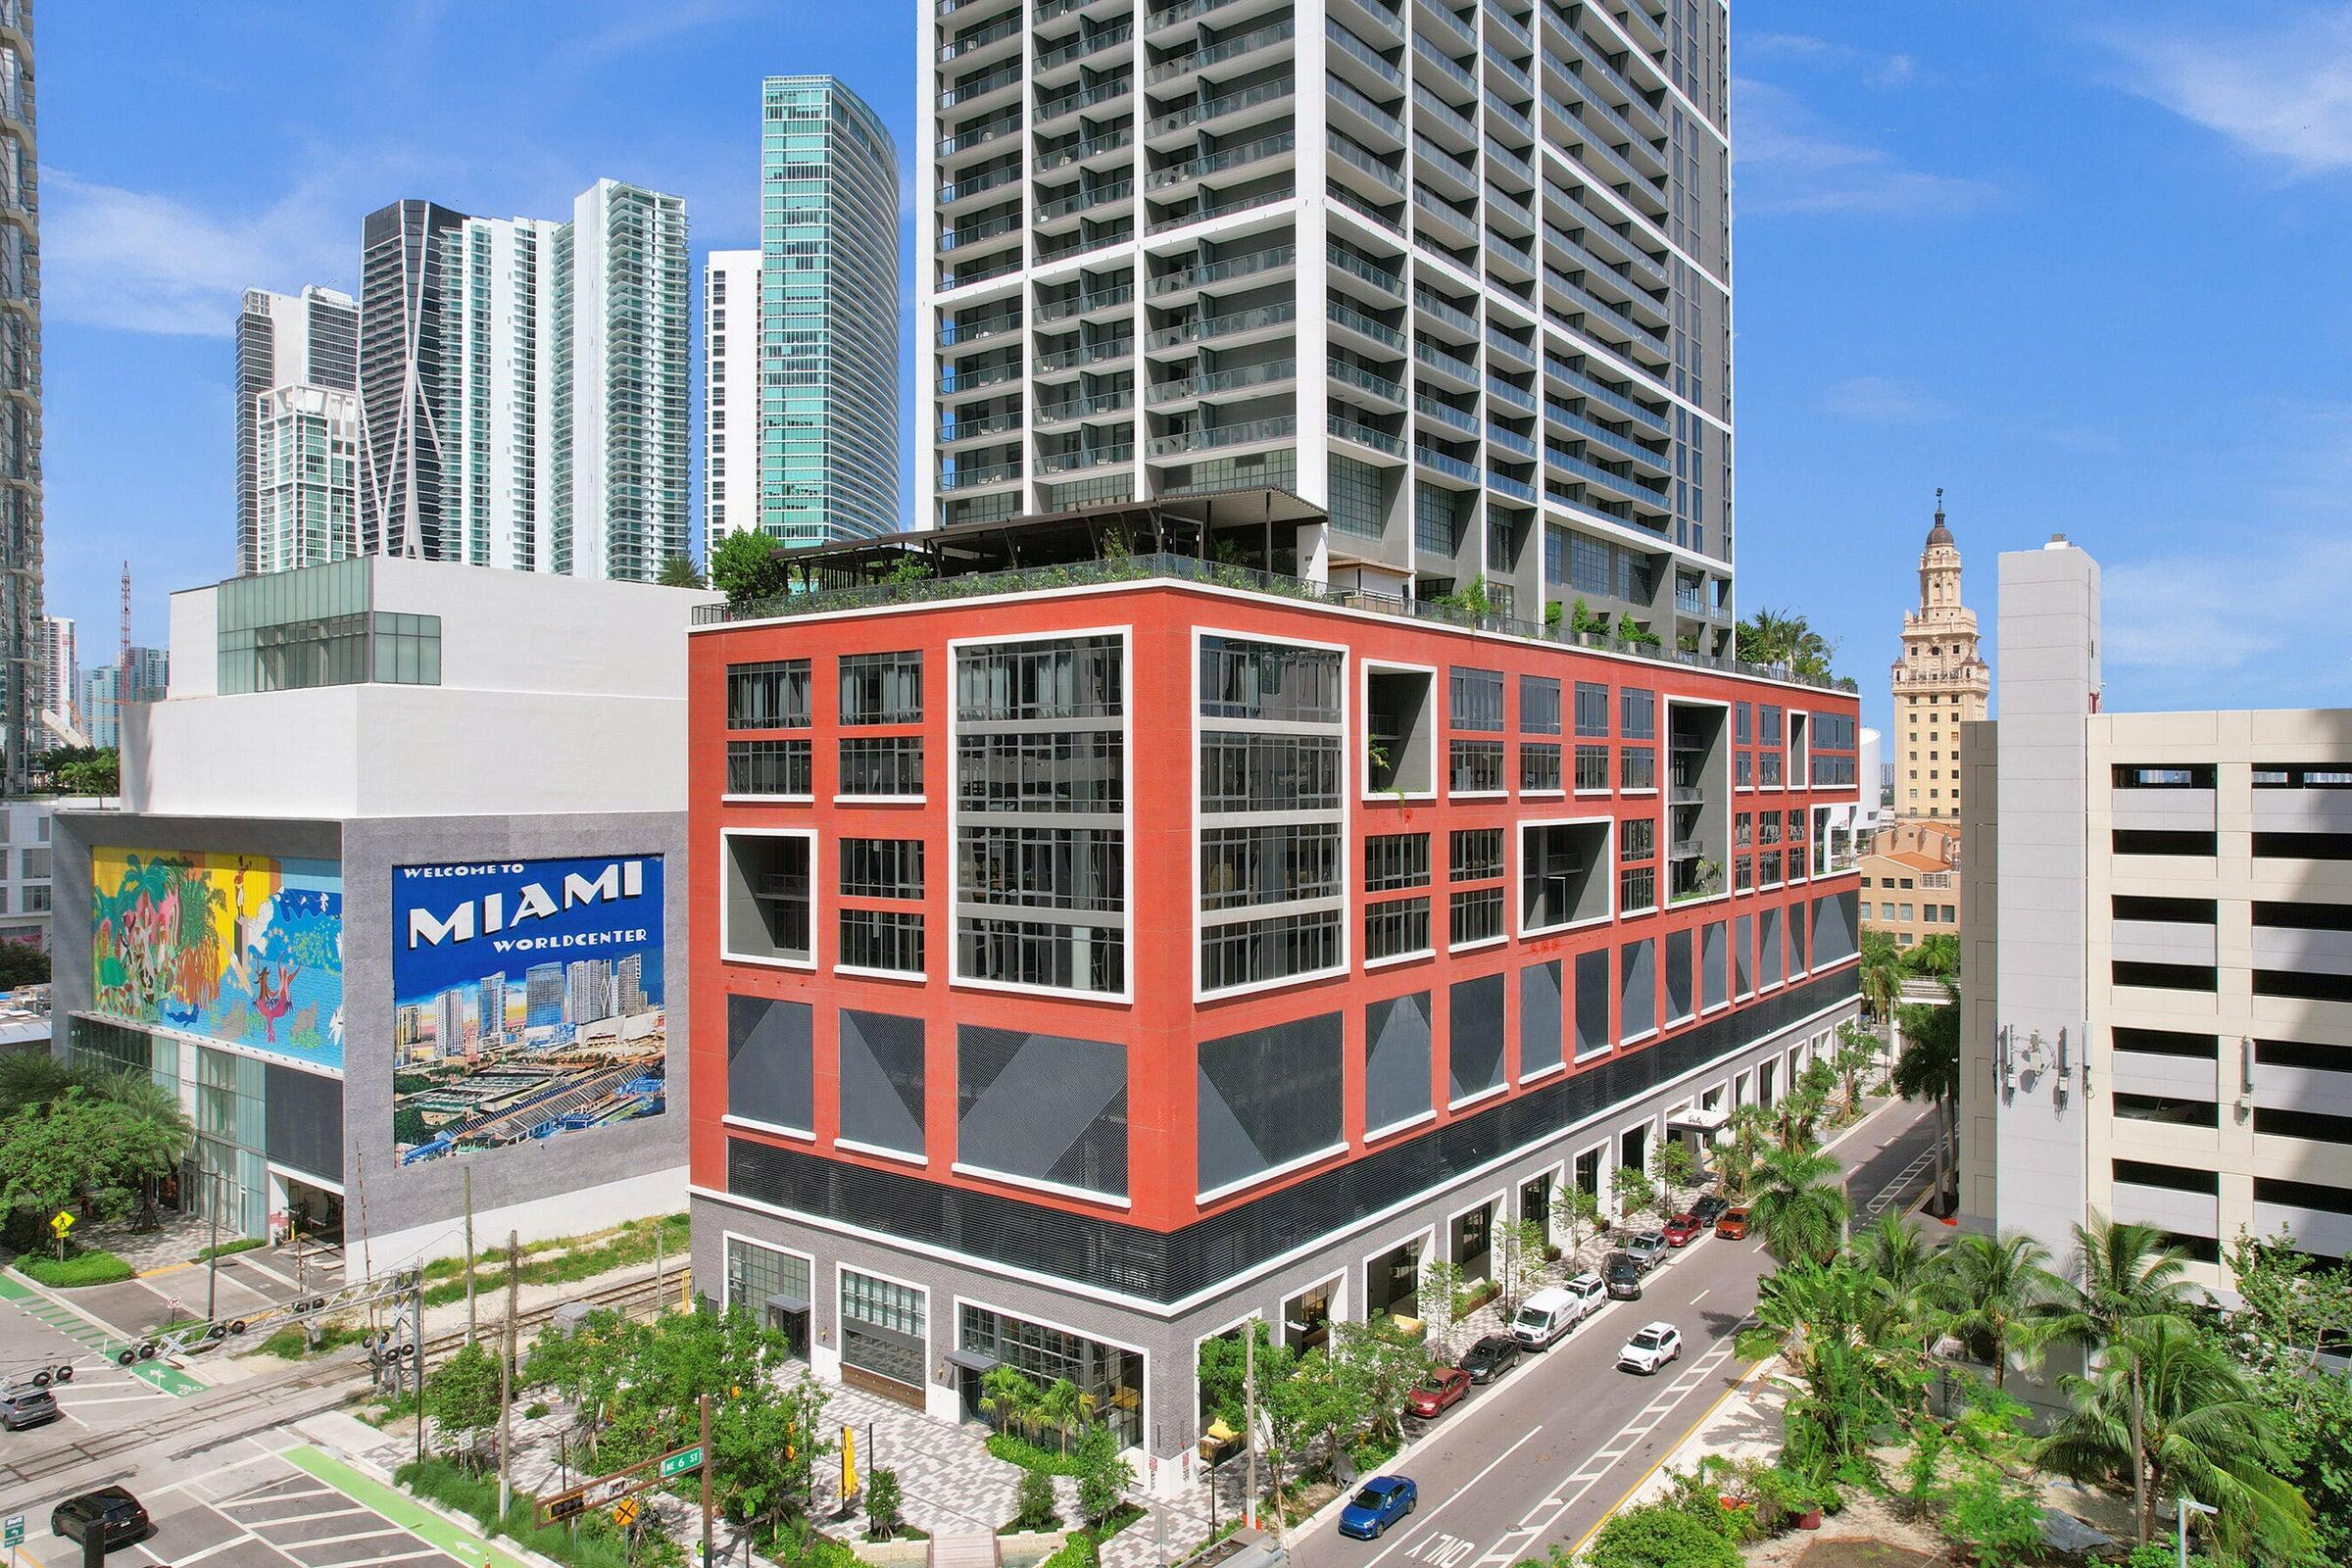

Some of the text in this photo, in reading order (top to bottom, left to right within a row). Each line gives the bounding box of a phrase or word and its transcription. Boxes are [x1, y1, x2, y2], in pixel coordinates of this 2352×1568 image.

[404, 863, 524, 879] WELCOME TO
[409, 860, 643, 950] MIAMI
[492, 928, 648, 954] WORLDCENTER
[677, 1456, 685, 1468] 6
[689, 1451, 699, 1463] ST
[1403, 1531, 1476, 1568] ONLY
